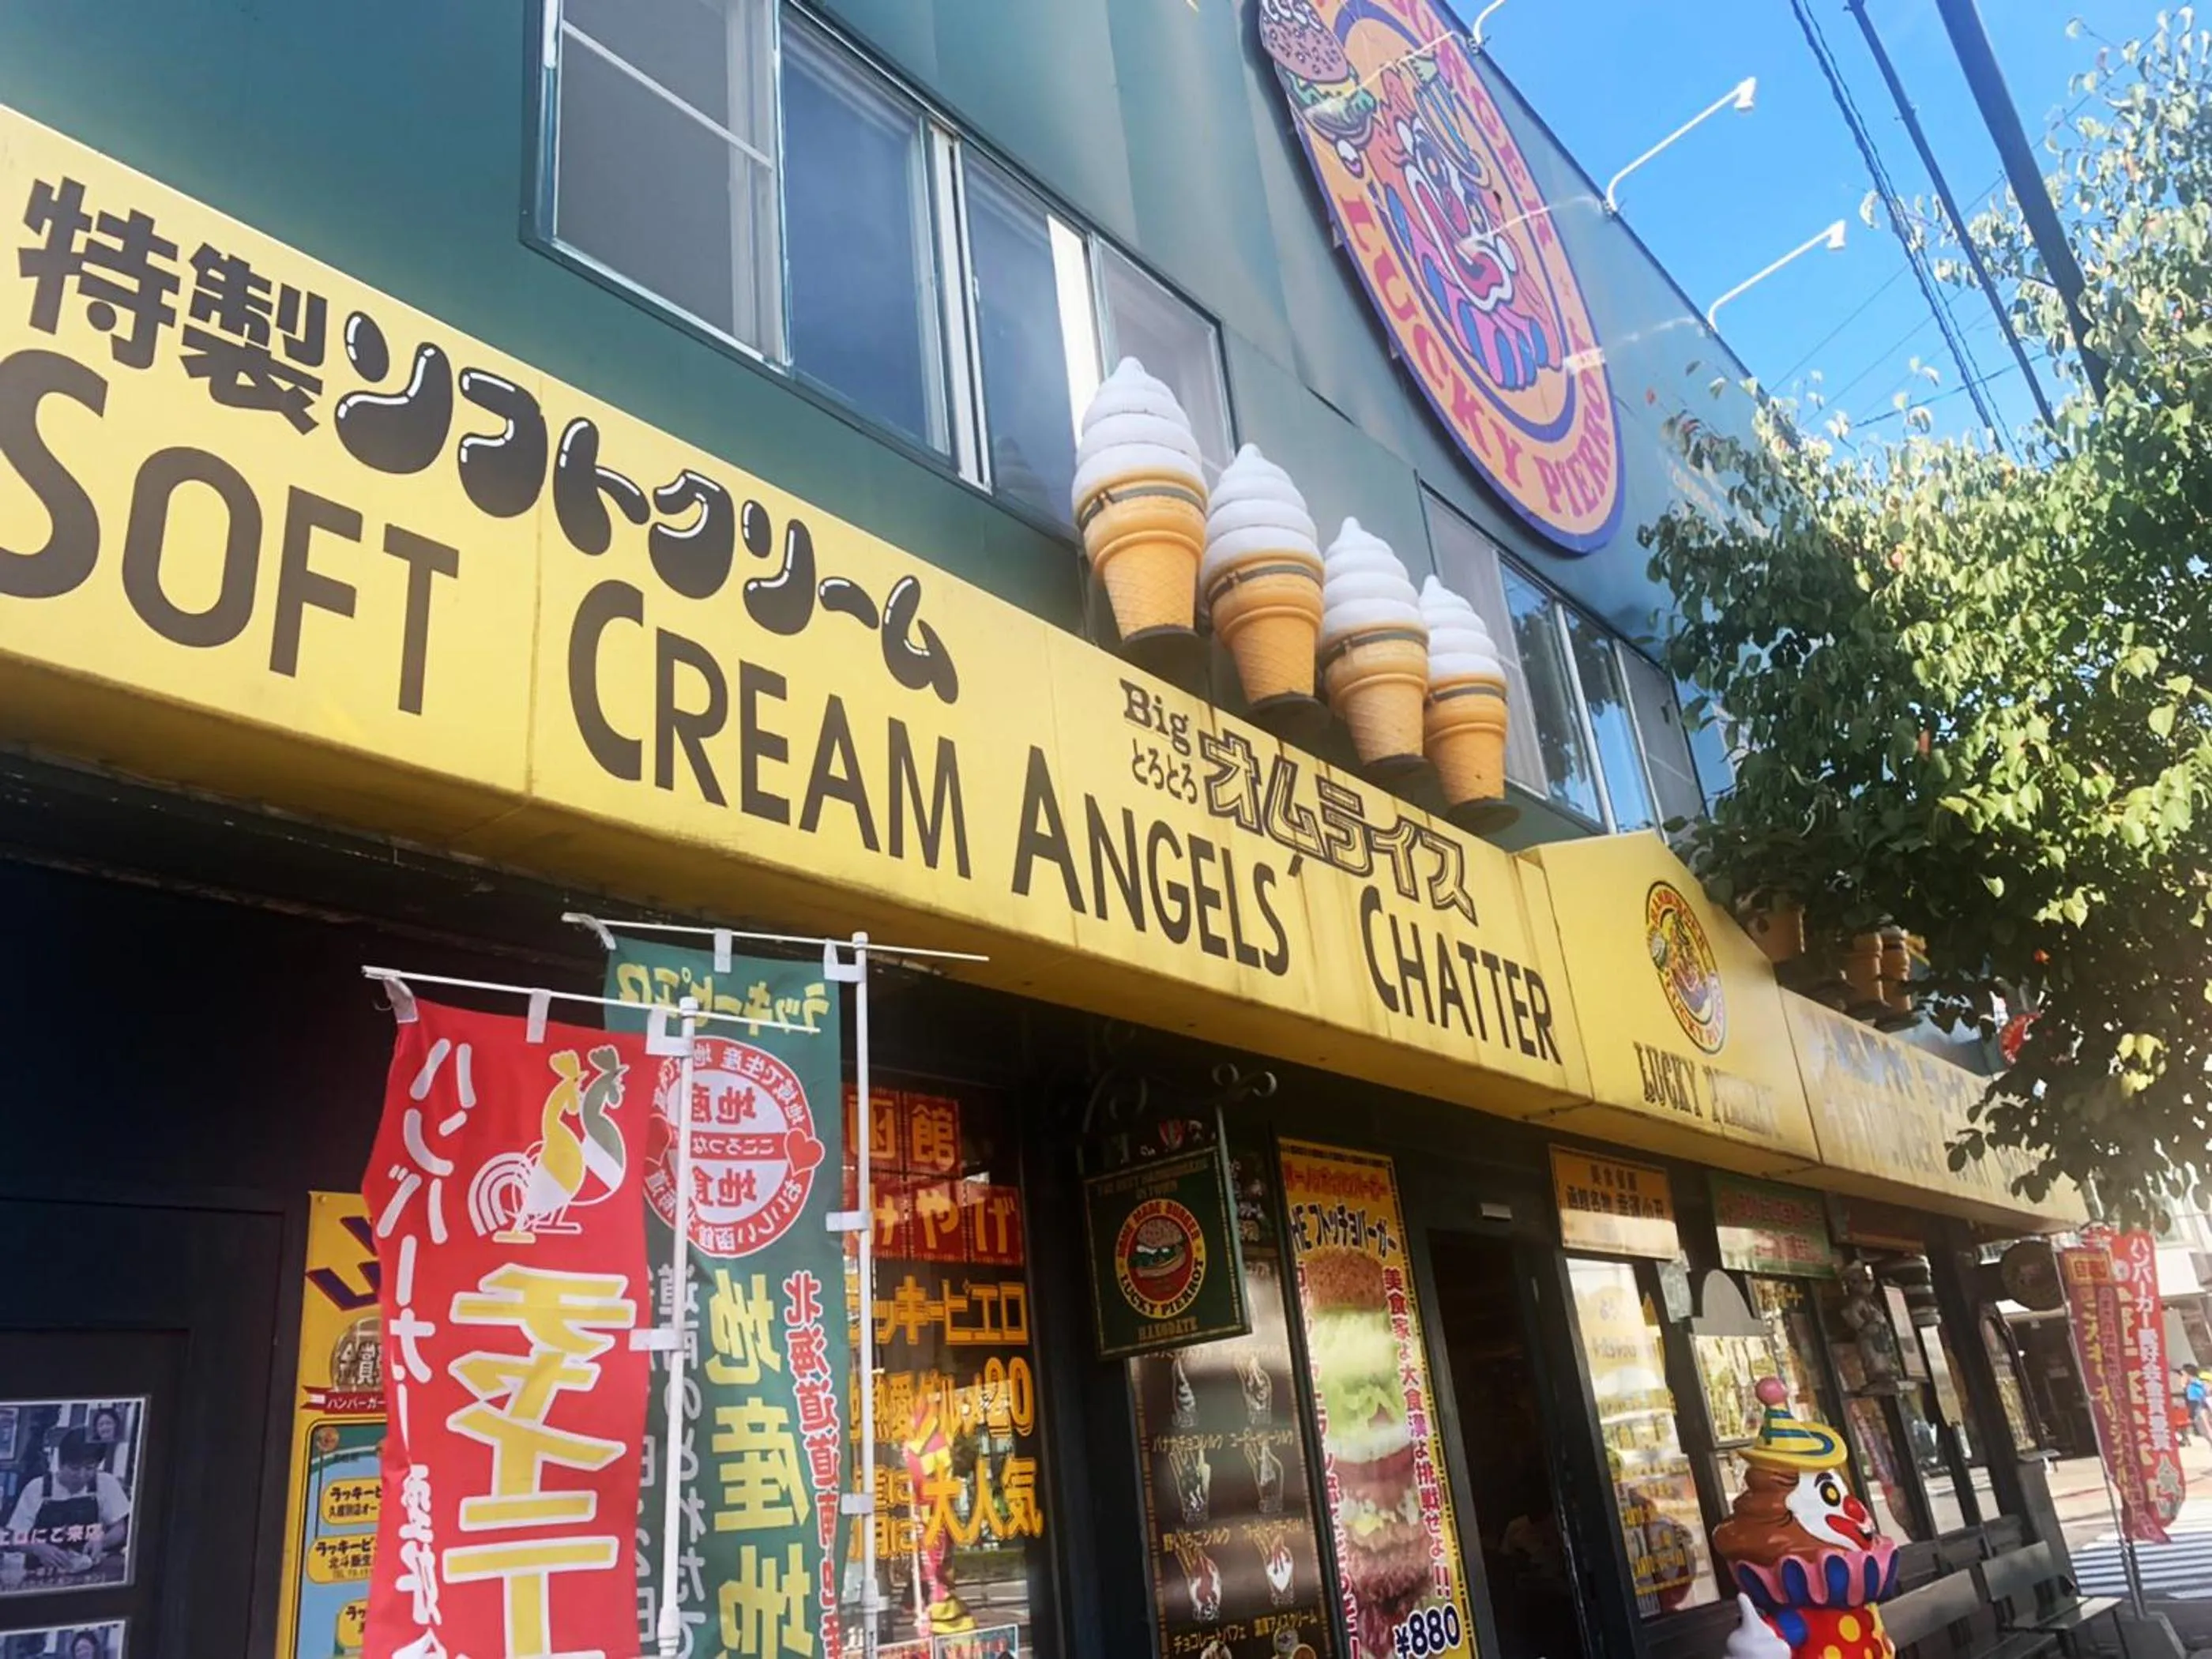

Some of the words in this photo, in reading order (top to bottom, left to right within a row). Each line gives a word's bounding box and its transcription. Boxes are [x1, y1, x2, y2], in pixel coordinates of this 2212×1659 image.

[17, 176, 958, 705] 特製ソフトクリーム
[1337, 192, 1525, 487] LUCKY
[0, 349, 460, 713] SOFT
[568, 579, 972, 880] CREAM
[1360, 885, 1563, 1065] CHATTER
[1119, 678, 1192, 756] Big
[1131, 738, 1198, 805] とろとろ
[1198, 724, 1479, 927] オムライス
[1395, 1604, 1461, 1657] ¥880
